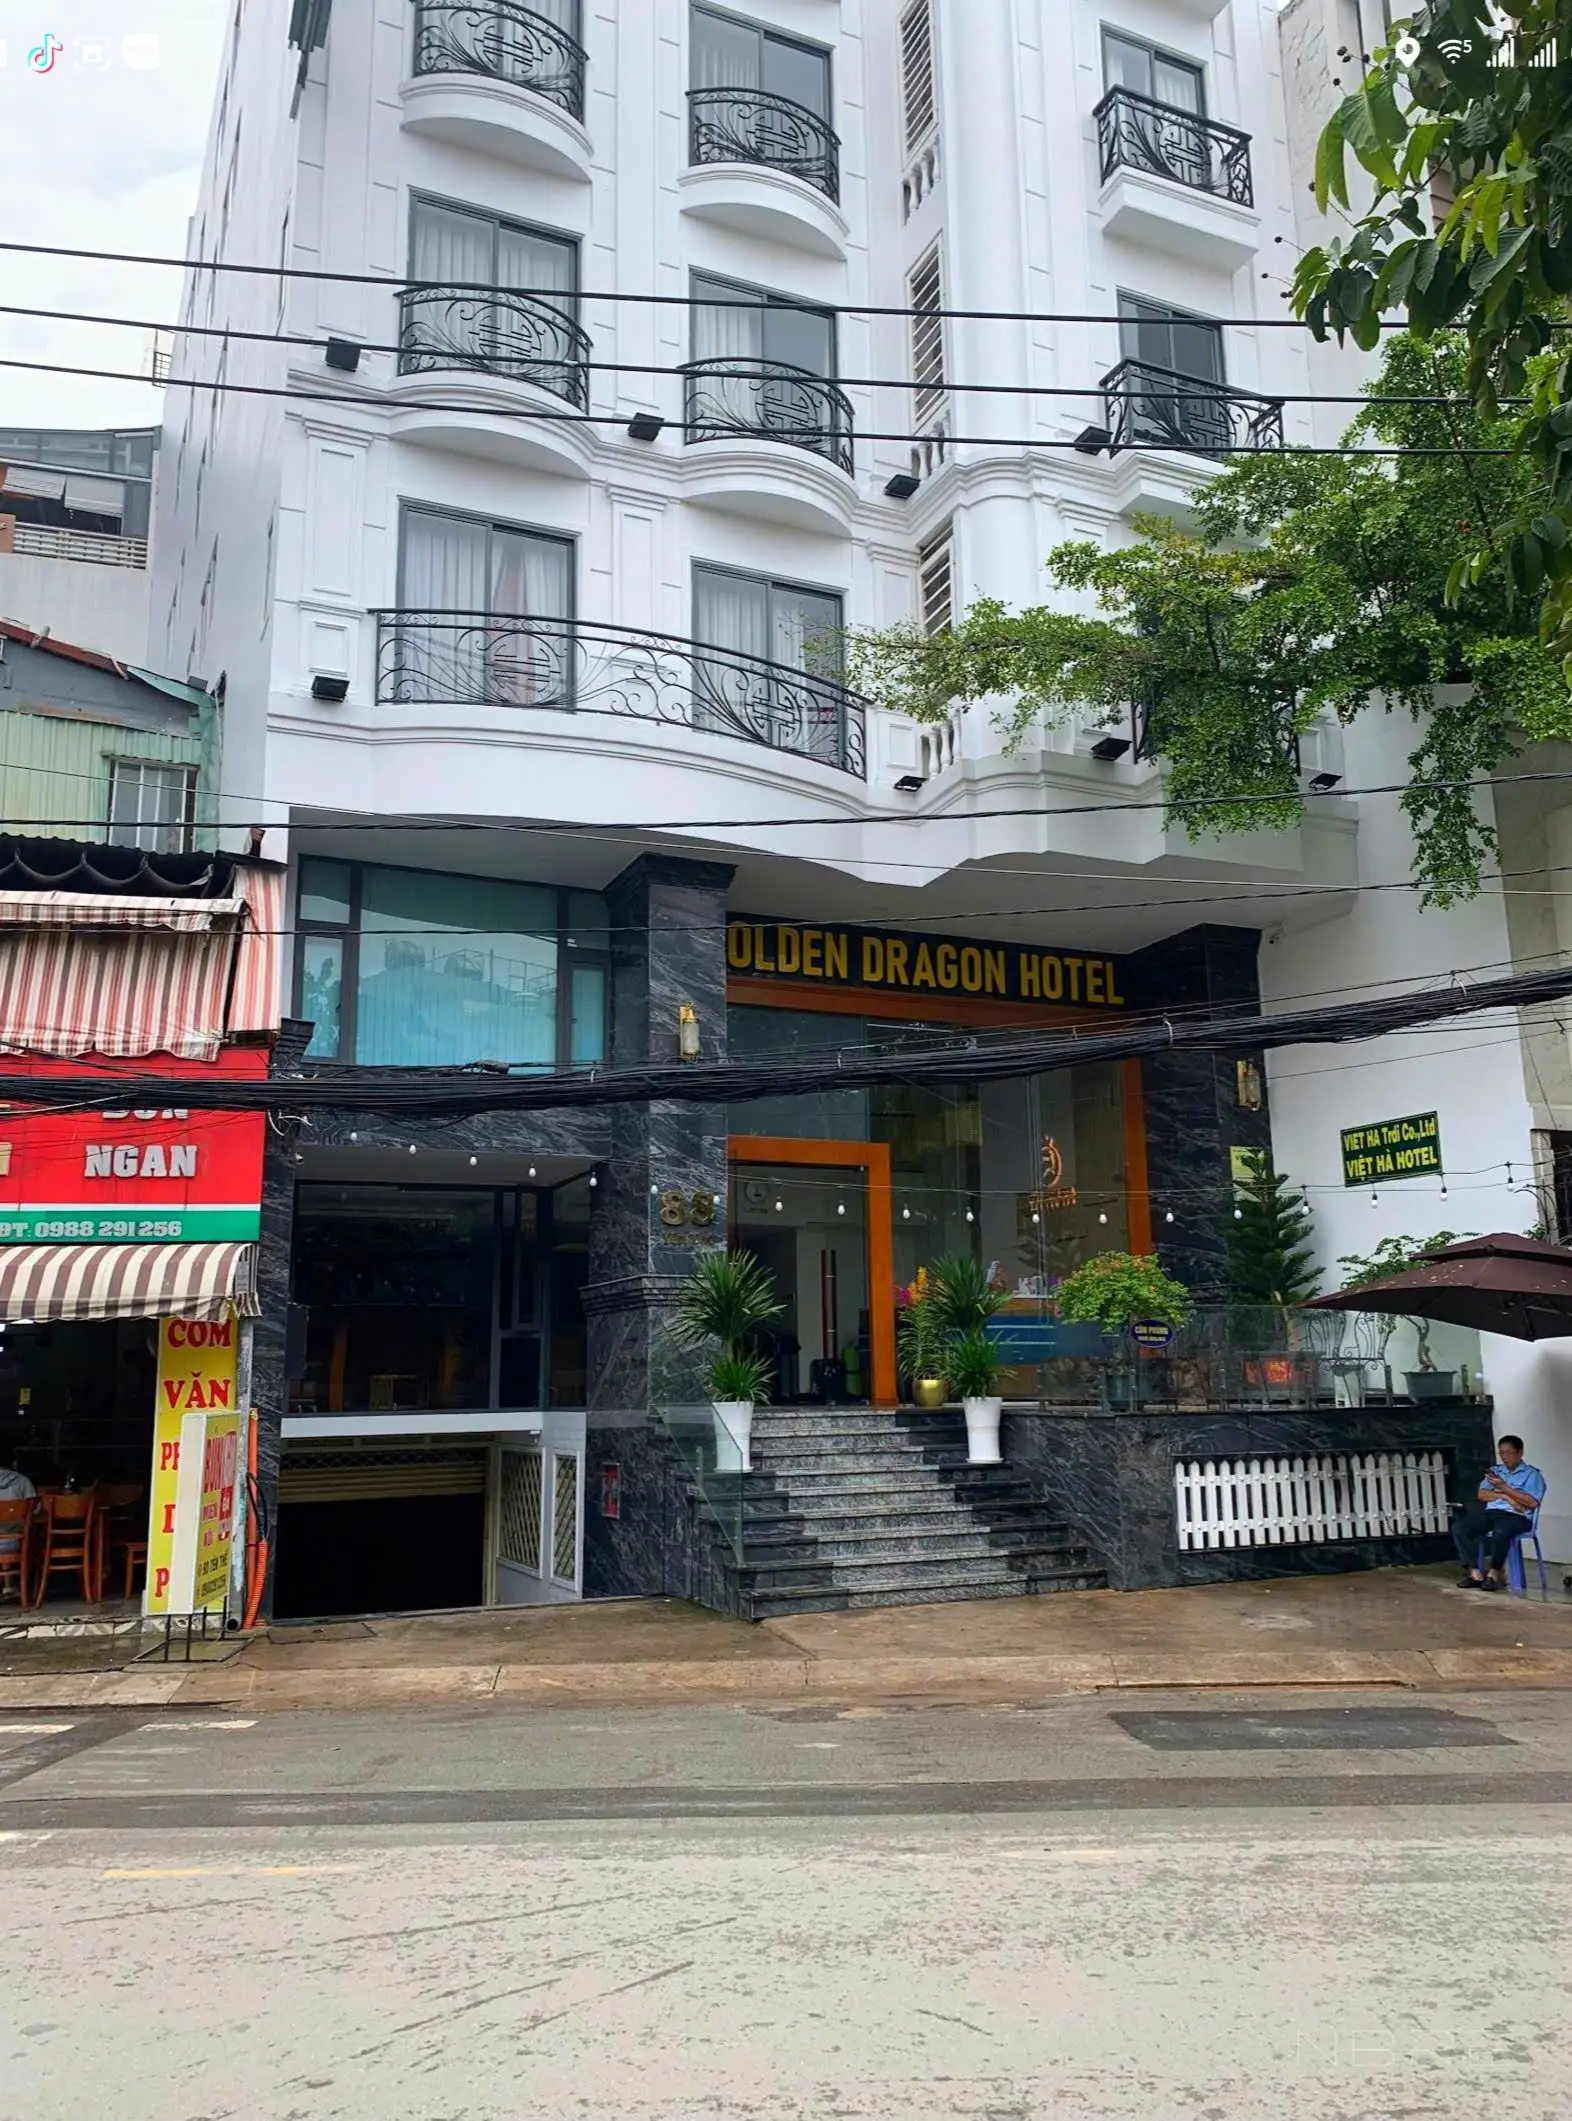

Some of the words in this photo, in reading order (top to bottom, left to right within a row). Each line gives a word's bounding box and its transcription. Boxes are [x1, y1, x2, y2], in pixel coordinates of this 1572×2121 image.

[727, 921, 848, 979] OLDEN
[862, 936, 1006, 995] DRAGON
[1020, 952, 1124, 1005] HOTEL
[1343, 1132, 1365, 1152] VIET
[1366, 1129, 1381, 1148] HA
[84, 1145, 198, 1178] NGAN
[1346, 1154, 1374, 1181] VIỆT
[1376, 1148, 1394, 1173] HÀ
[1395, 1146, 1438, 1169] HOTEL
[659, 1189, 716, 1226] 88
[34, 1221, 95, 1238] 0988
[163, 1371, 232, 1408] VĂN
